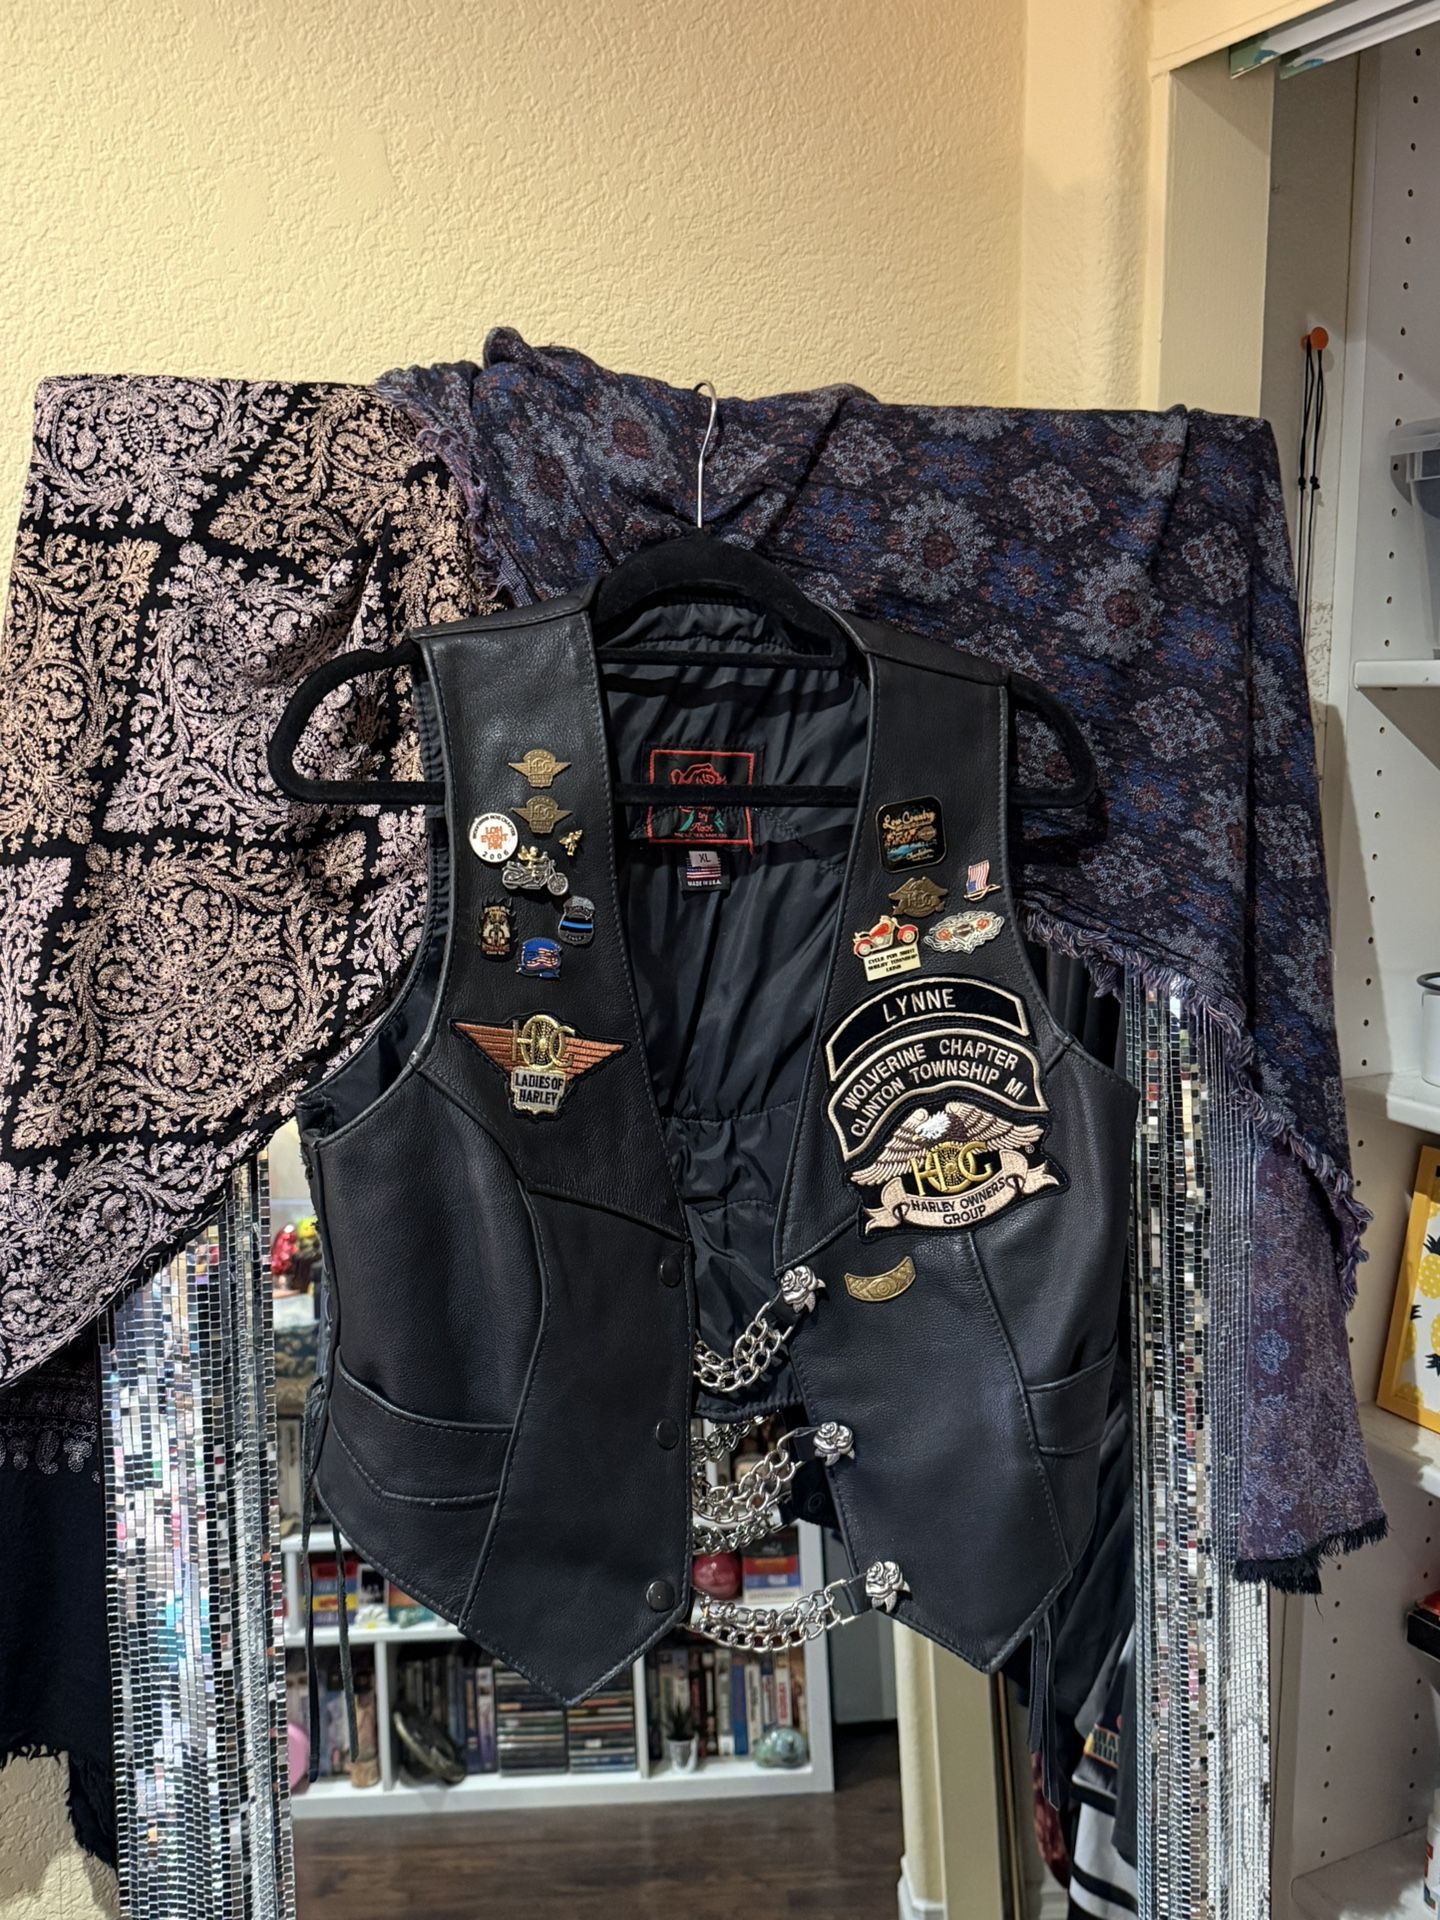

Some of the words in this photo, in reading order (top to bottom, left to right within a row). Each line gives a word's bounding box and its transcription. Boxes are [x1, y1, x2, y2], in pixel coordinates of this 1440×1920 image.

[482, 849, 509, 860] 2006
[699, 853, 711, 863] XL
[868, 956, 885, 965] CYCLE
[882, 988, 957, 1023] LYNNE
[515, 1072, 551, 1089] LADIES
[551, 1076, 565, 1091] OF
[842, 1043, 928, 1112] WOLVERINE
[938, 1038, 1019, 1071] CHAPTER
[518, 1088, 558, 1106] HARLEY
[850, 1077, 907, 1138] CLINTON
[908, 1059, 1000, 1085] TOWNSHIP
[1003, 1077, 1028, 1101] MI
[911, 1199, 956, 1213] HARLEY
[959, 1175, 1006, 1209] OWNERS
[942, 1204, 987, 1225] GROUP
